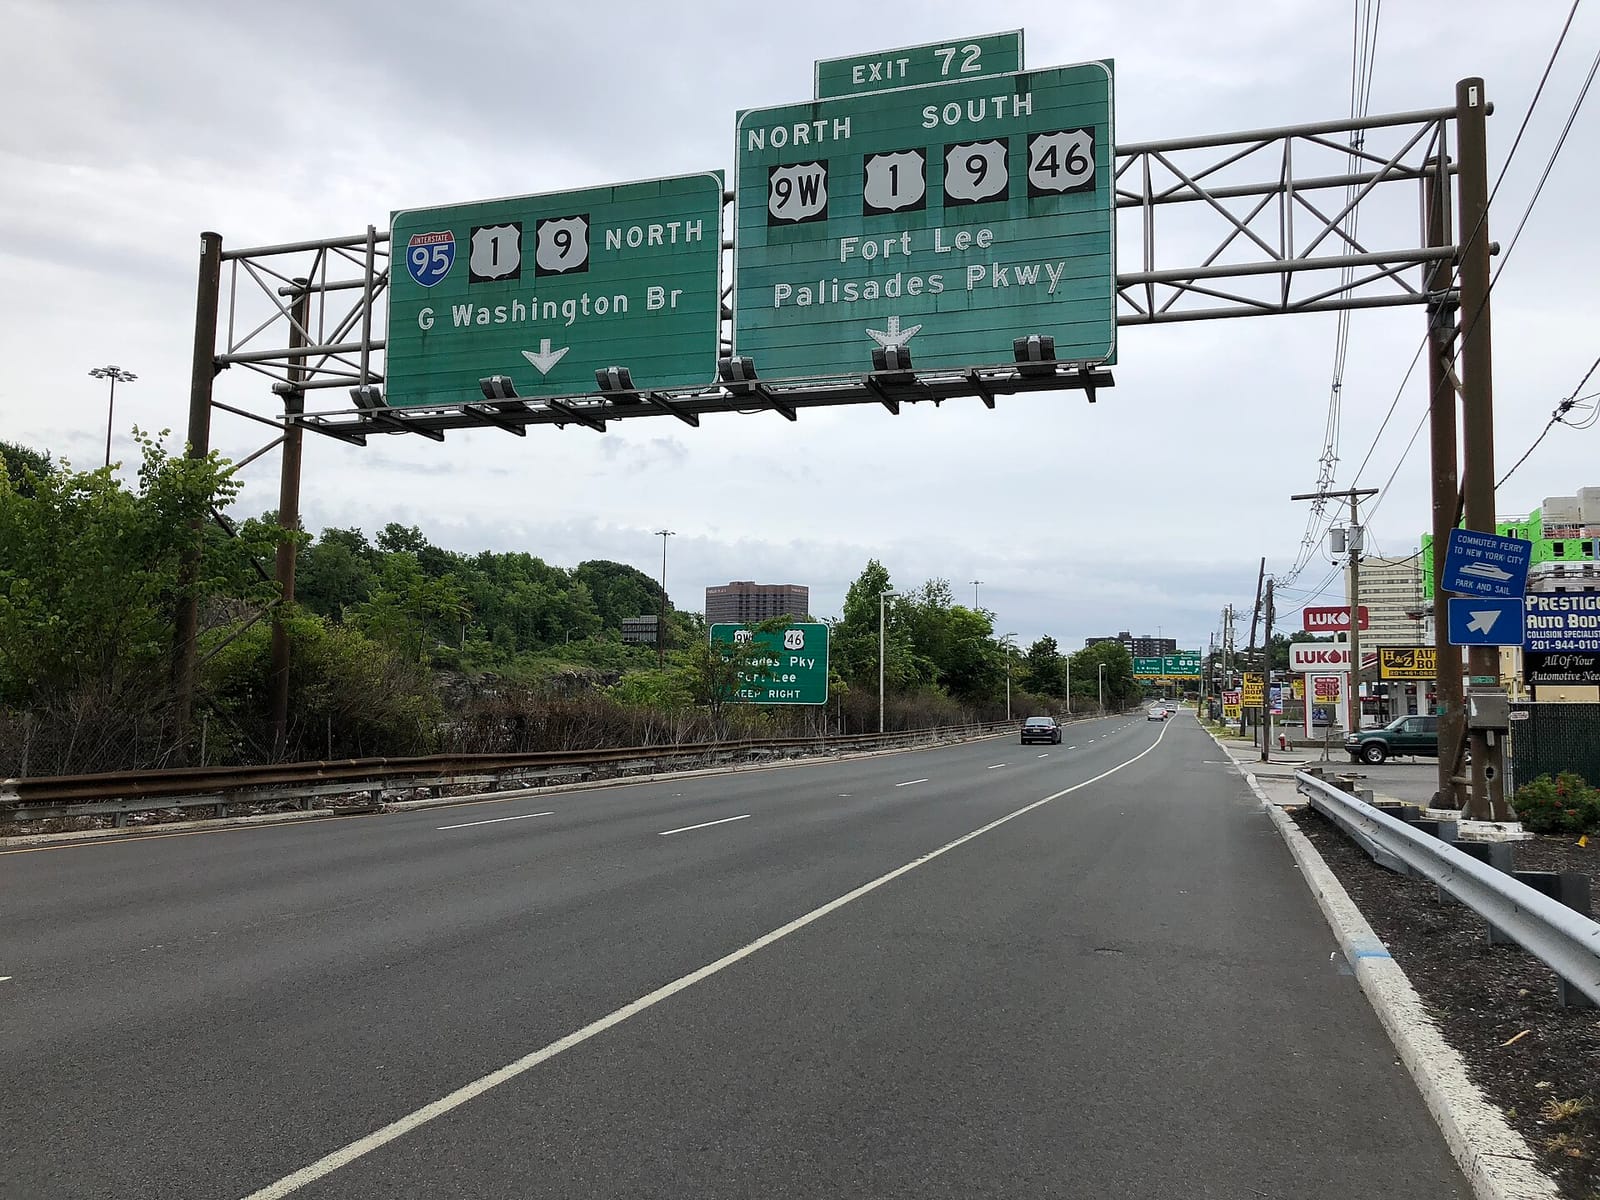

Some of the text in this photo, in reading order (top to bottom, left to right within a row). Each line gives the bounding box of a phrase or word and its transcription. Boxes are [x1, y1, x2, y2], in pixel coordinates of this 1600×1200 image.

[851, 44, 982, 84] EXIT 72
[921, 92, 1033, 129] SOUTH
[748, 117, 851, 152] NORTH
[965, 154, 988, 187] 9
[1034, 142, 1089, 178] 46
[774, 173, 821, 210] 9W
[888, 164, 898, 197] 1
[413, 233, 450, 244] INTERSTATE
[553, 229, 573, 259] 9
[605, 219, 703, 251] NORTH
[840, 228, 994, 263] Fort Lee
[411, 246, 449, 277] 95
[490, 236, 499, 267] 1
[773, 261, 1066, 309] Palisades Pkwy
[418, 286, 684, 331] G Washington Br
[1454, 546, 1524, 565] TO NEW YORK CITY
[1457, 535, 1524, 553] COMMUTER FERRY
[1455, 579, 1511, 595] PARK AND SAIL
[787, 634, 802, 646] 46
[1526, 630, 1562, 639] COLLISION
[1531, 640, 1600, 650] 201-944-010
[789, 656, 815, 670] Pky
[1529, 670, 1581, 682] Automotive
[1542, 654, 1595, 669] All Of Your
[768, 690, 801, 698] RIGHT
